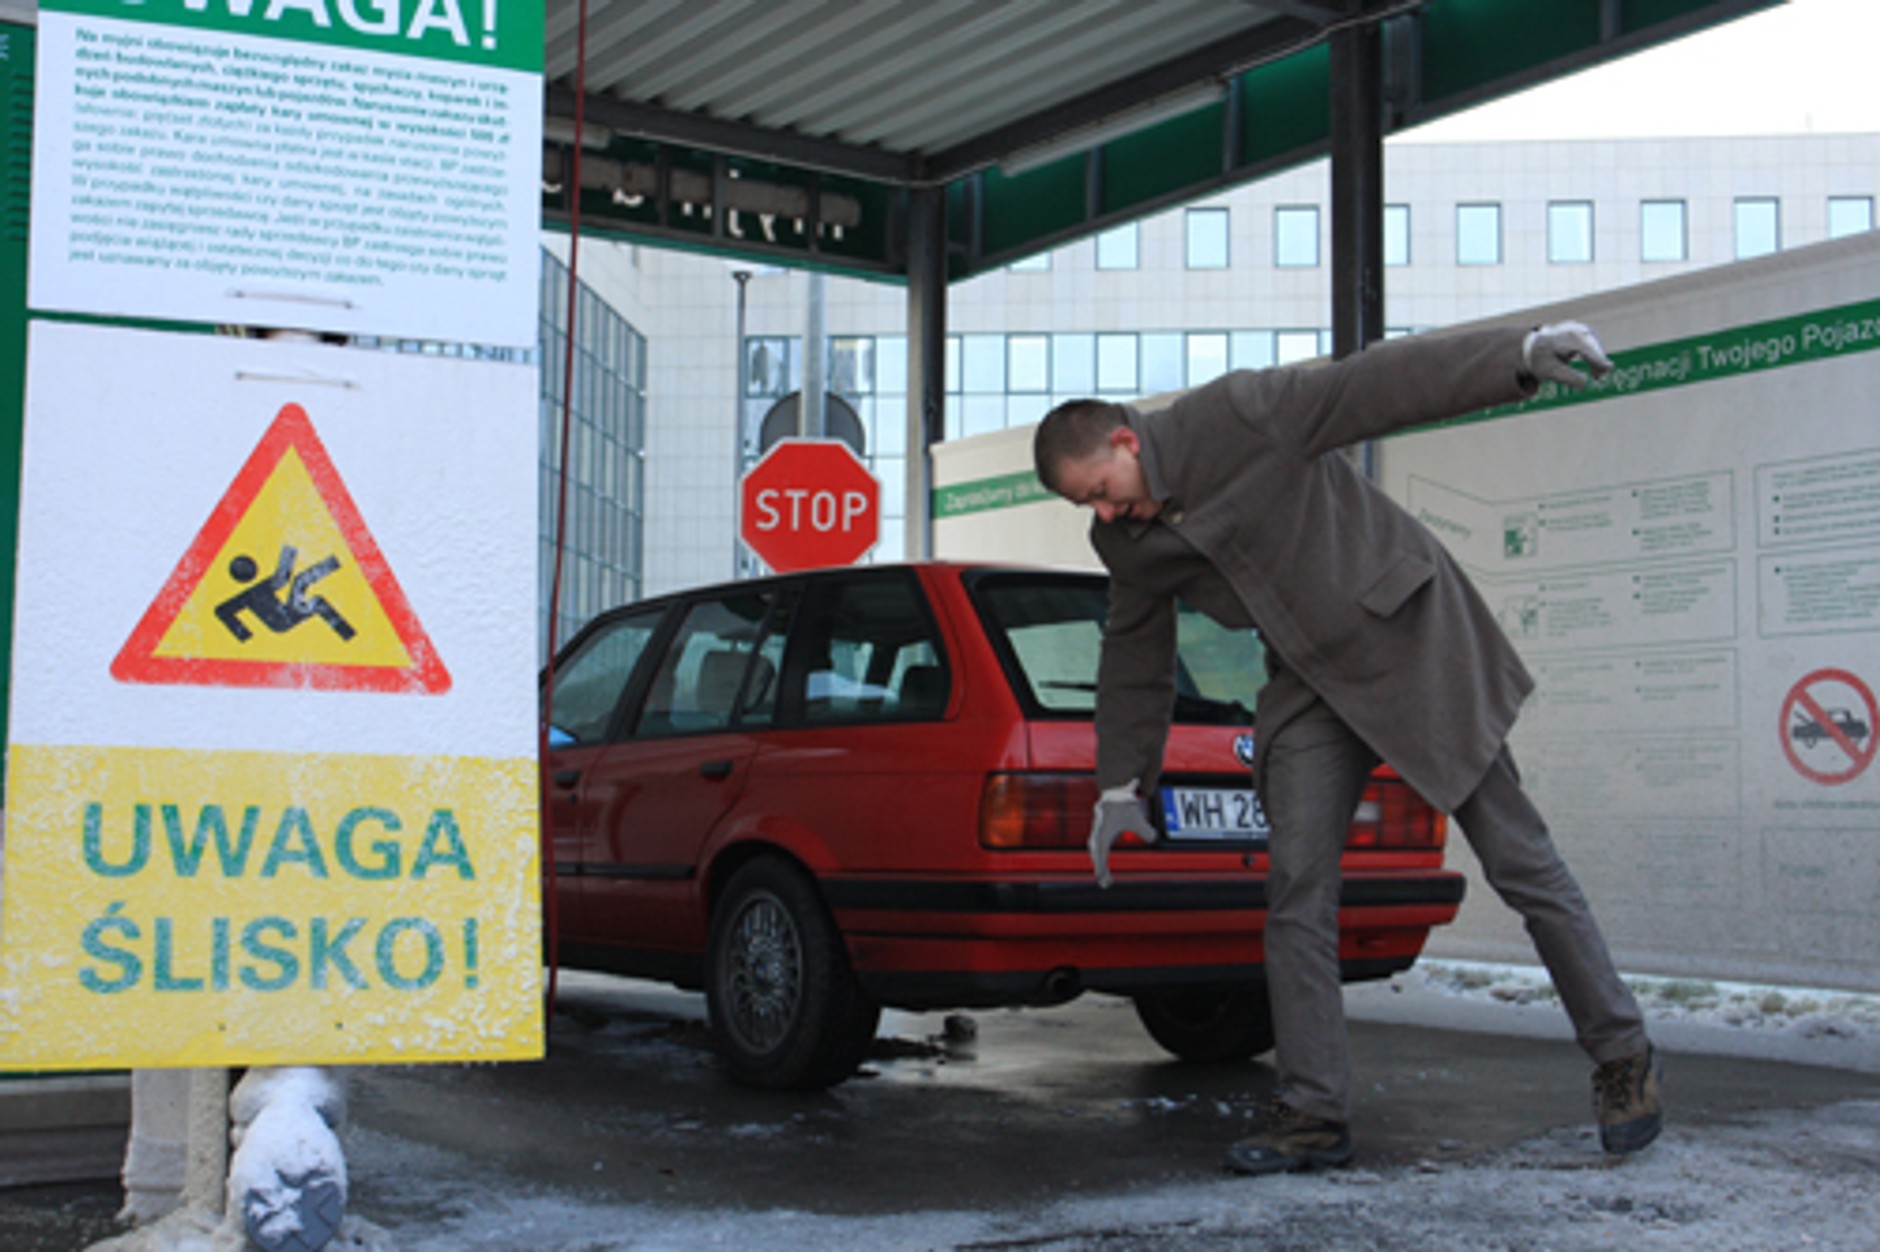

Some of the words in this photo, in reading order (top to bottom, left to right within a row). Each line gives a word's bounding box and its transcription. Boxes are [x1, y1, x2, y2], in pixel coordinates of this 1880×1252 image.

[122, 0, 497, 50] GA!
[1696, 334, 1796, 370] Twojego
[755, 488, 868, 533] STOP
[1179, 792, 1228, 828] WH
[82, 802, 476, 881] UWAGA
[78, 901, 479, 994] ŚLISKO!
